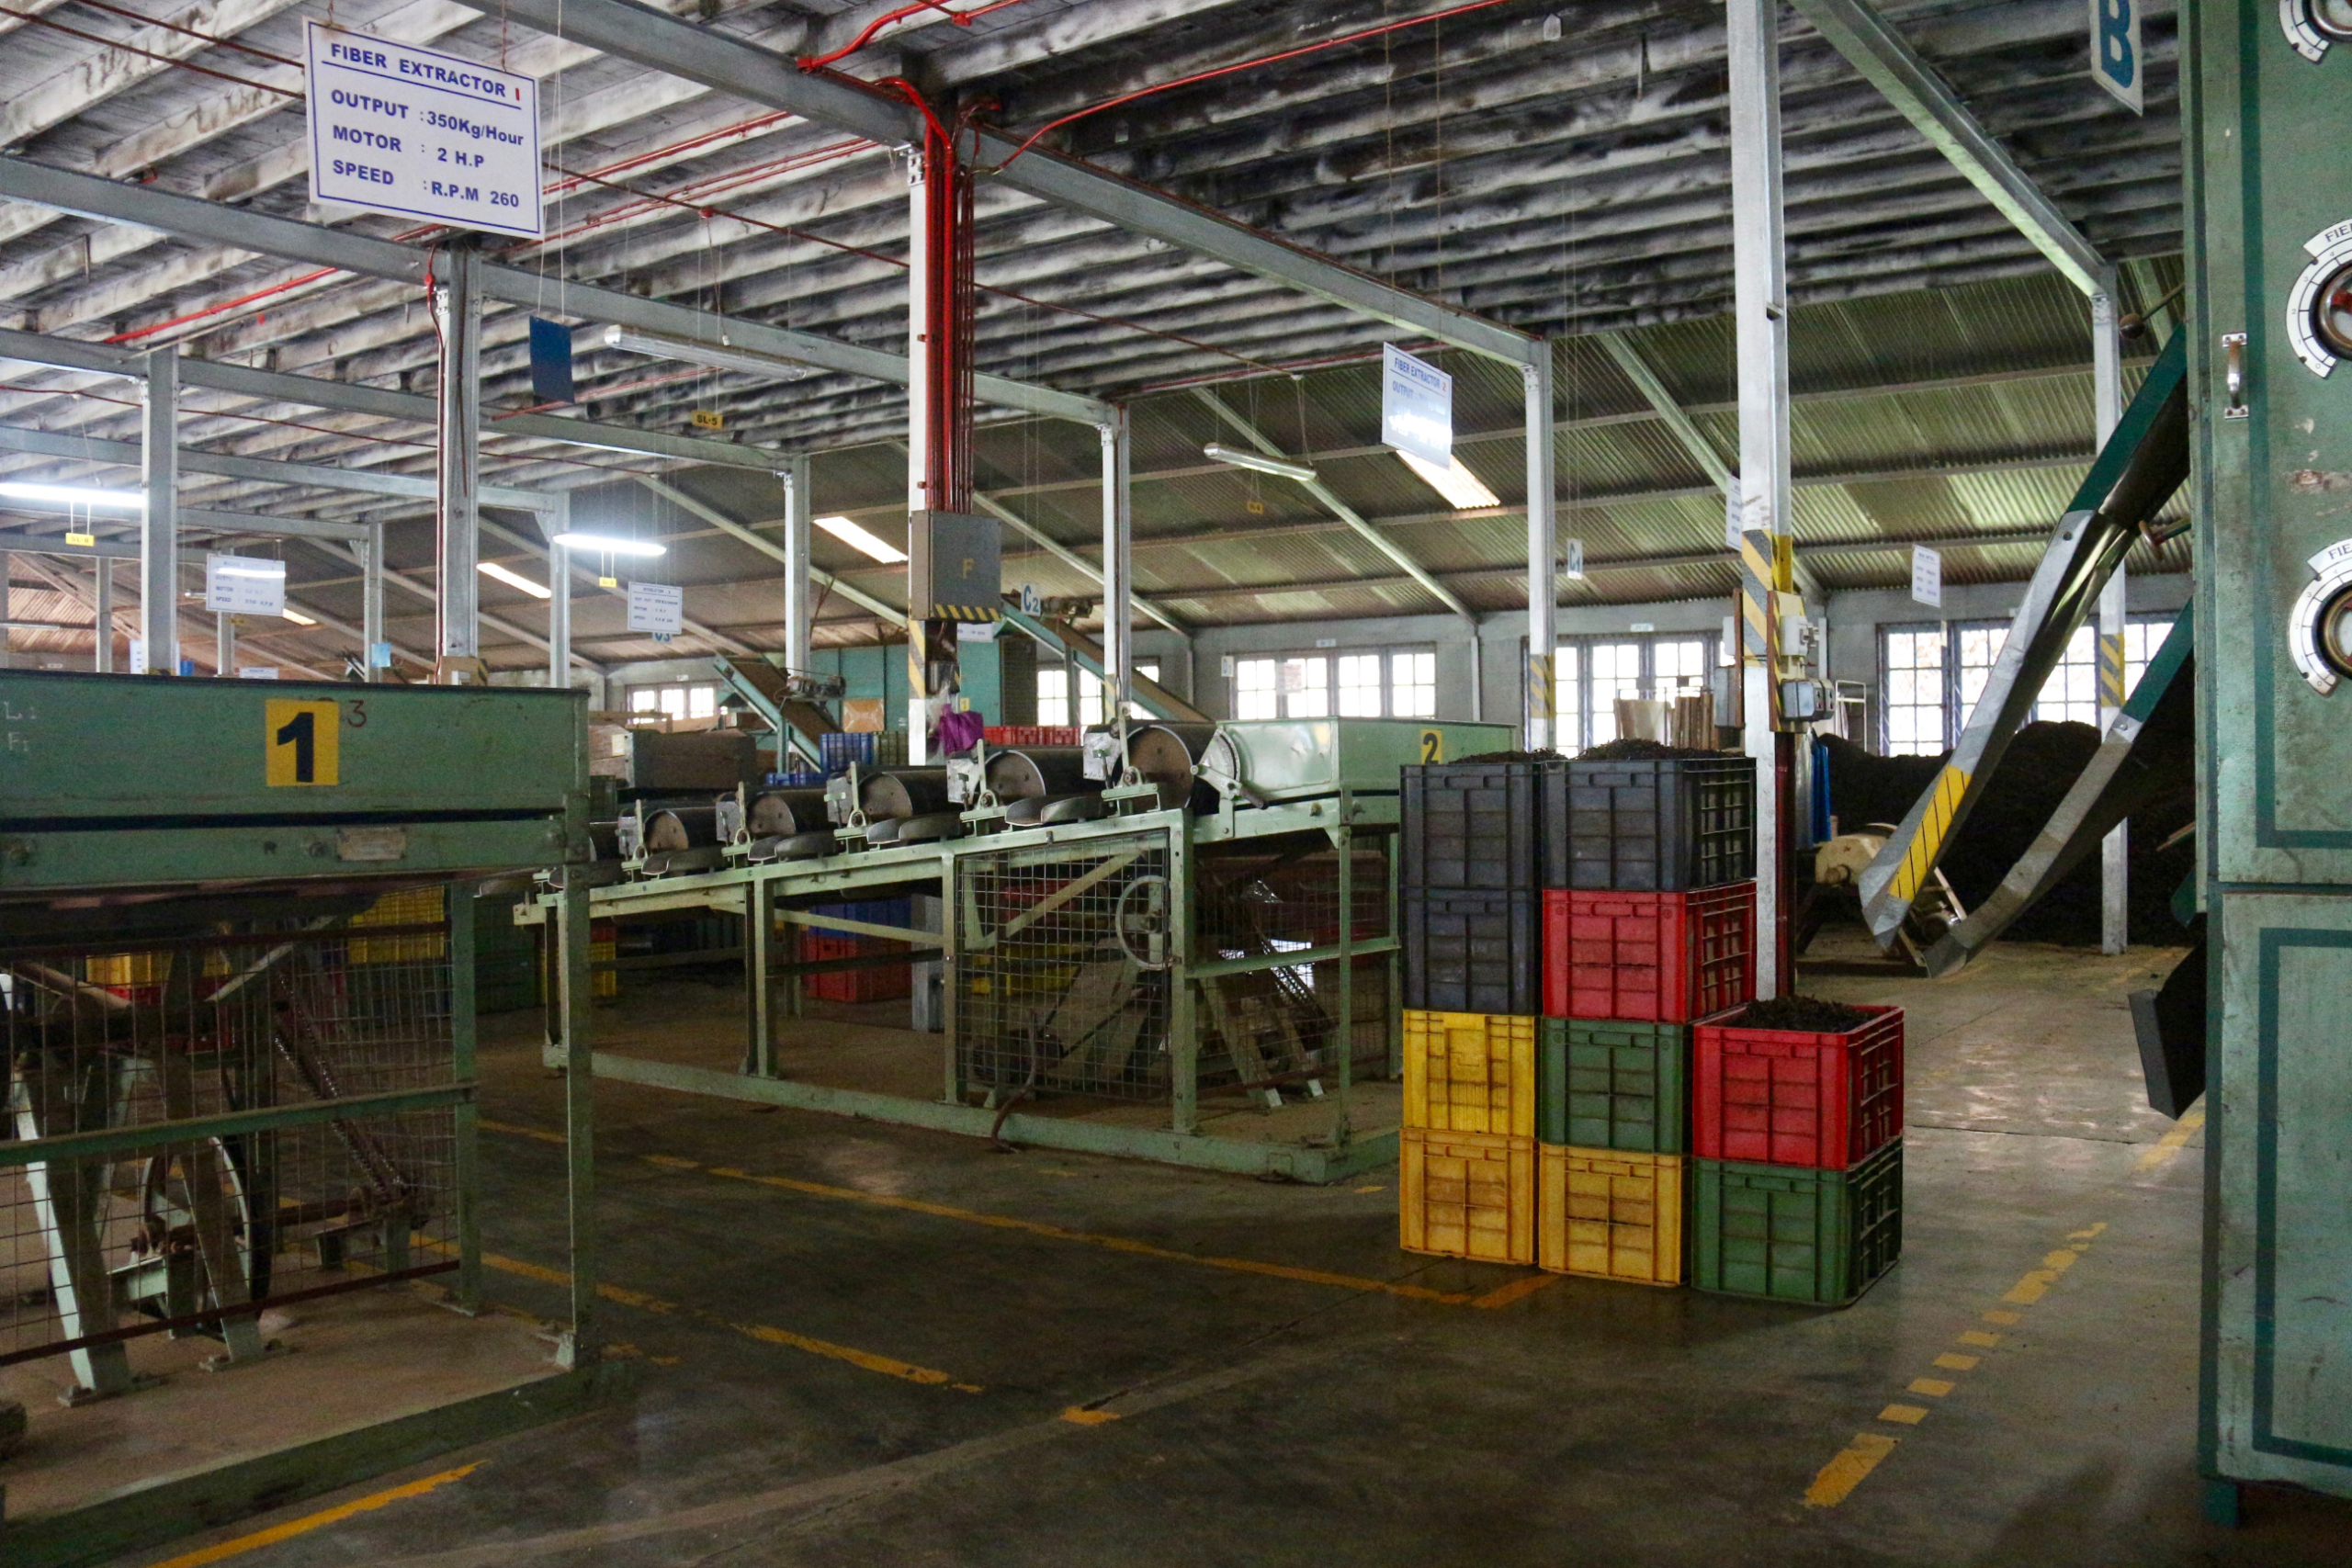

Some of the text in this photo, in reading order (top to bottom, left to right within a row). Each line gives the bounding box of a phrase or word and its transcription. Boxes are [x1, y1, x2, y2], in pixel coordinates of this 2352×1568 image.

[2099, 0, 2134, 88] B
[331, 42, 387, 69] FIBER
[399, 58, 506, 97] EXTRACTOR
[331, 89, 409, 119] OUTPUT
[333, 125, 401, 152] MOTOR
[437, 148, 447, 163] 2
[455, 151, 485, 168] H.P
[333, 159, 394, 186] SPEED
[490, 190, 519, 208] 260
[2324, 223, 2352, 243] FIE
[1393, 380, 1414, 400] OUTPUT
[1395, 357, 1447, 392] FIBER EXTRACTOR 2
[1023, 584, 1039, 614] C2
[347, 699, 368, 728] 3
[277, 711, 315, 784] 1
[1423, 732, 1439, 765] 2
